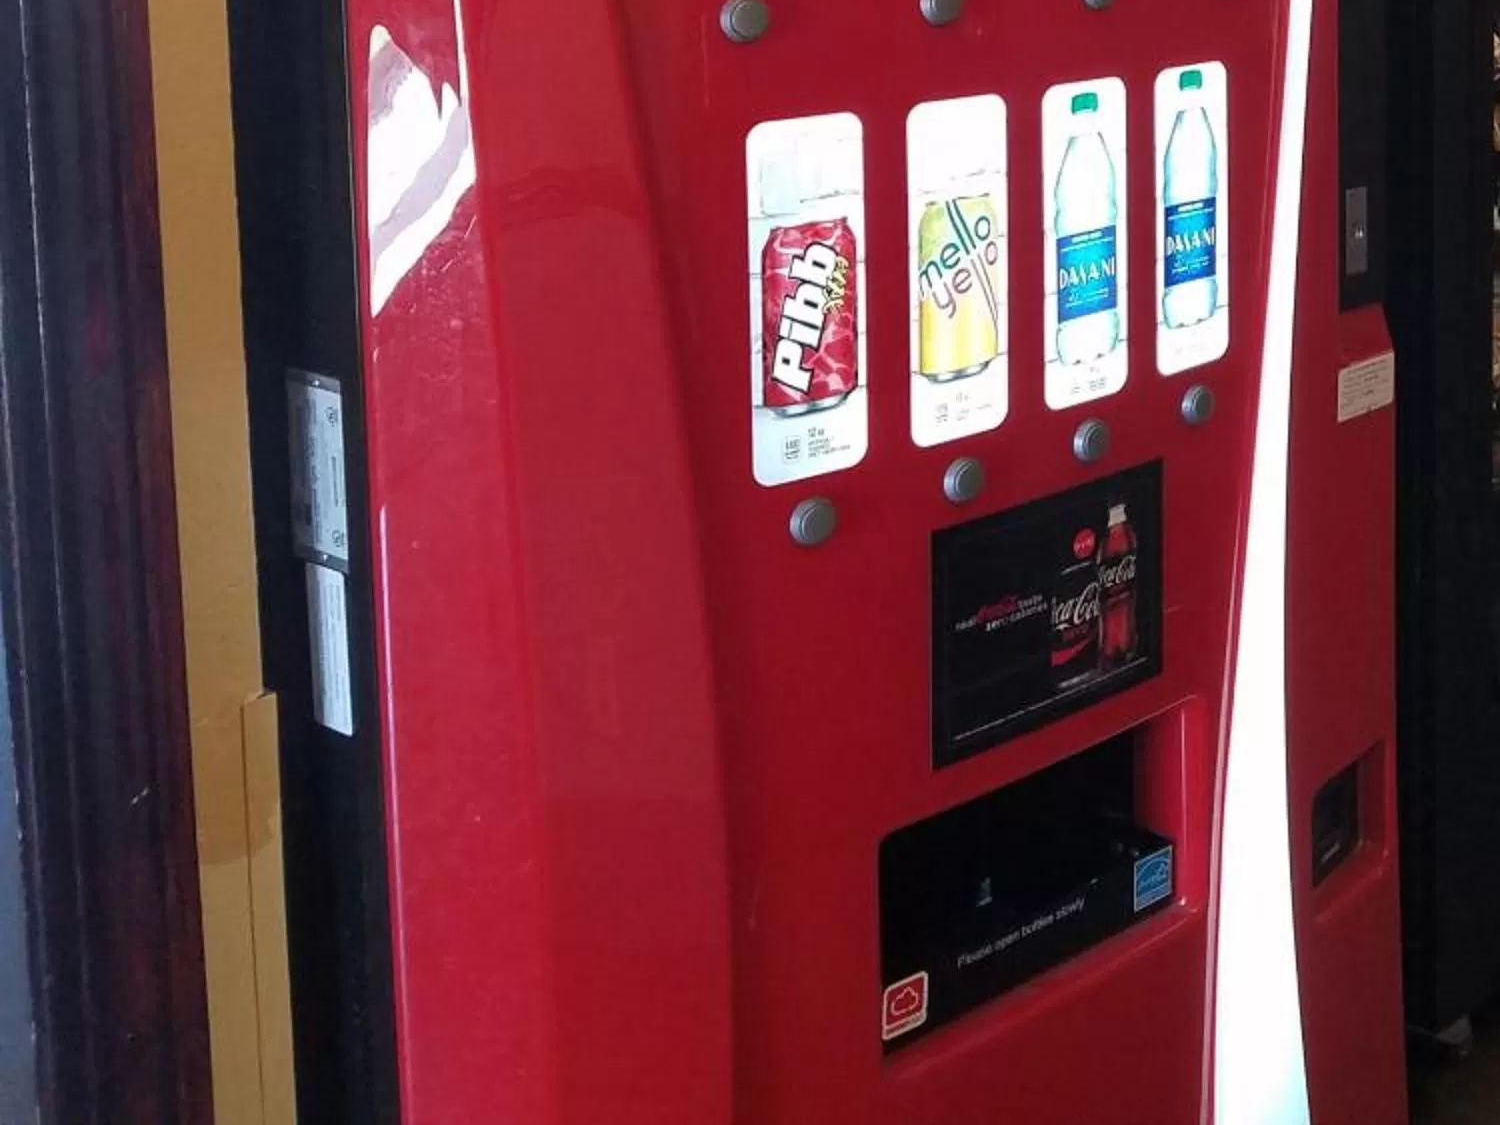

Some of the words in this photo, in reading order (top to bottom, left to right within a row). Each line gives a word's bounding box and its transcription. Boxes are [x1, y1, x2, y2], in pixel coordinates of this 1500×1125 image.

[920, 199, 992, 296] mello
[1166, 225, 1216, 256] DASANI
[932, 240, 999, 324] yello
[1059, 256, 1115, 289] DASANI
